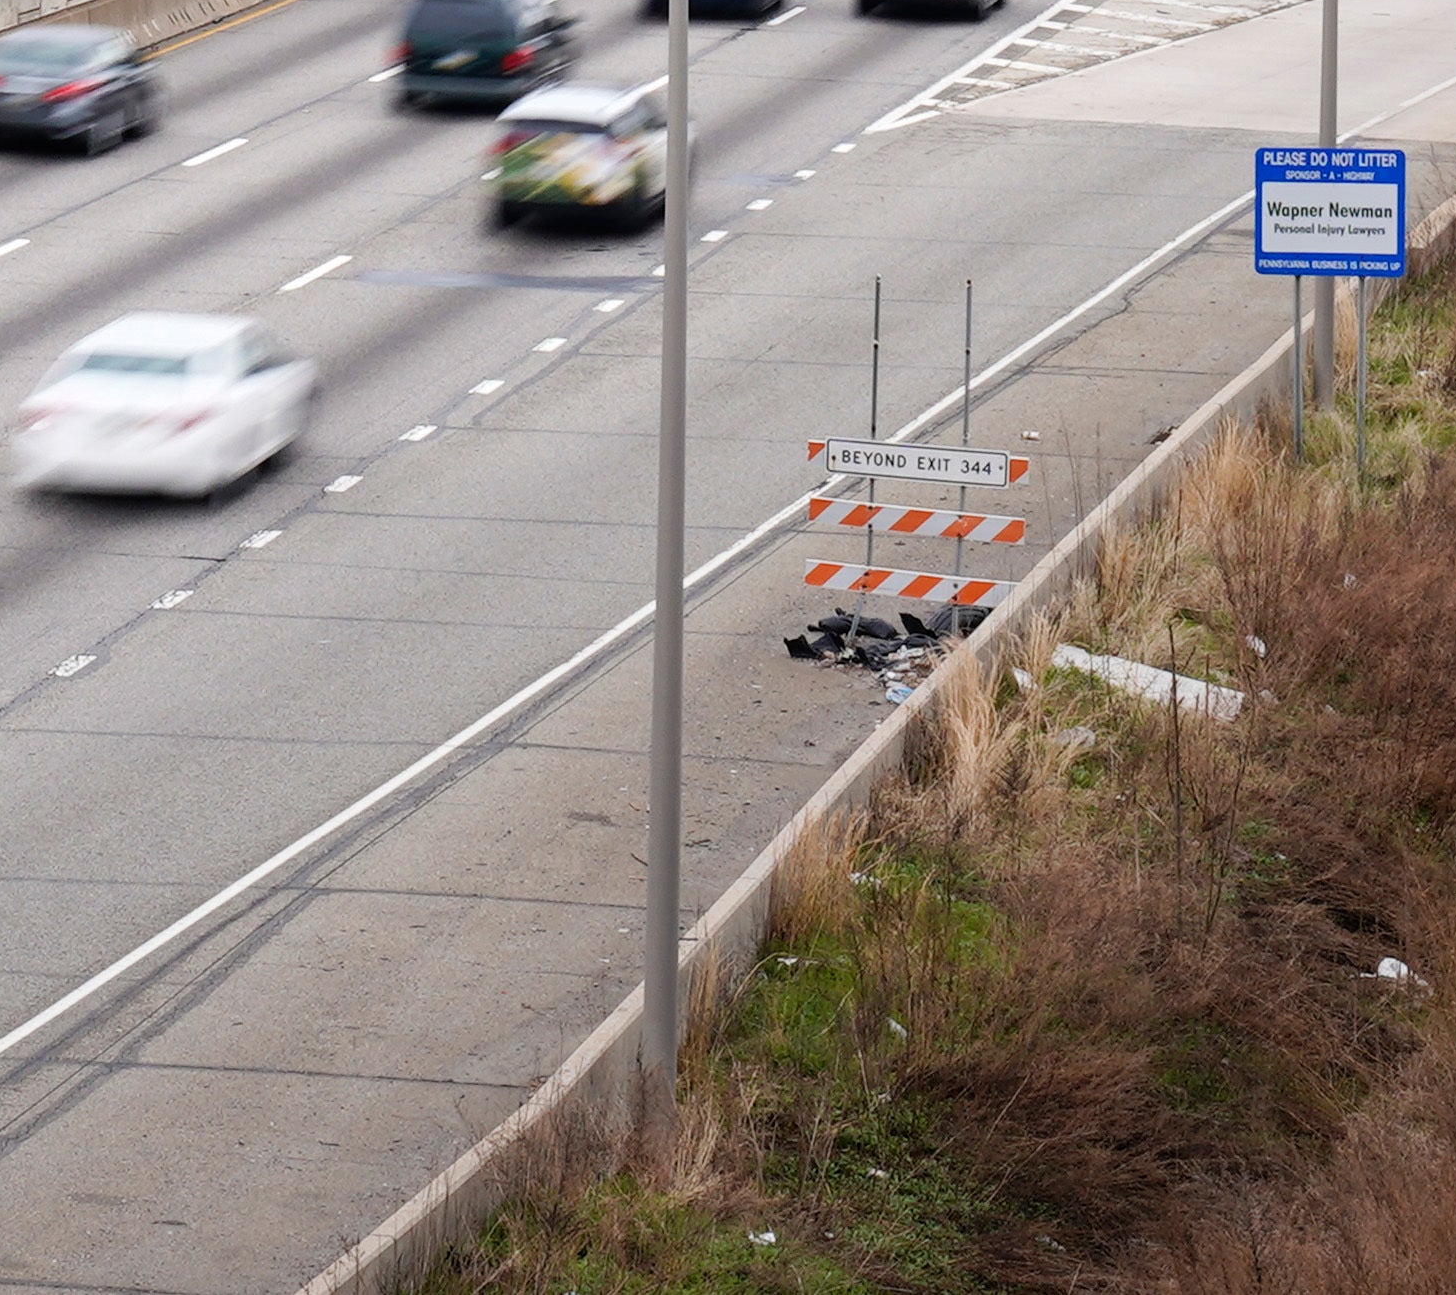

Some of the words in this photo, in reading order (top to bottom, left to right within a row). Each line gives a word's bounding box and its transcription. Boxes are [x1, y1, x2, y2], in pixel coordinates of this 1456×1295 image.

[1263, 151, 1306, 166] PLEASE
[1310, 152, 1328, 166] DO
[1332, 152, 1355, 167] NOT
[1358, 153, 1397, 168] LITTER
[1286, 170, 1320, 180] SPONSOR
[1343, 172, 1375, 181] HIGHWAY
[1267, 202, 1324, 220] Wapner
[1329, 202, 1393, 218] Newman
[1274, 222, 1315, 234] Personal
[1317, 224, 1345, 237] Injury
[1348, 224, 1386, 237] Lawyers
[842, 450, 907, 468] BEYOND
[917, 456, 951, 472] EXIT
[960, 460, 992, 475] 344
